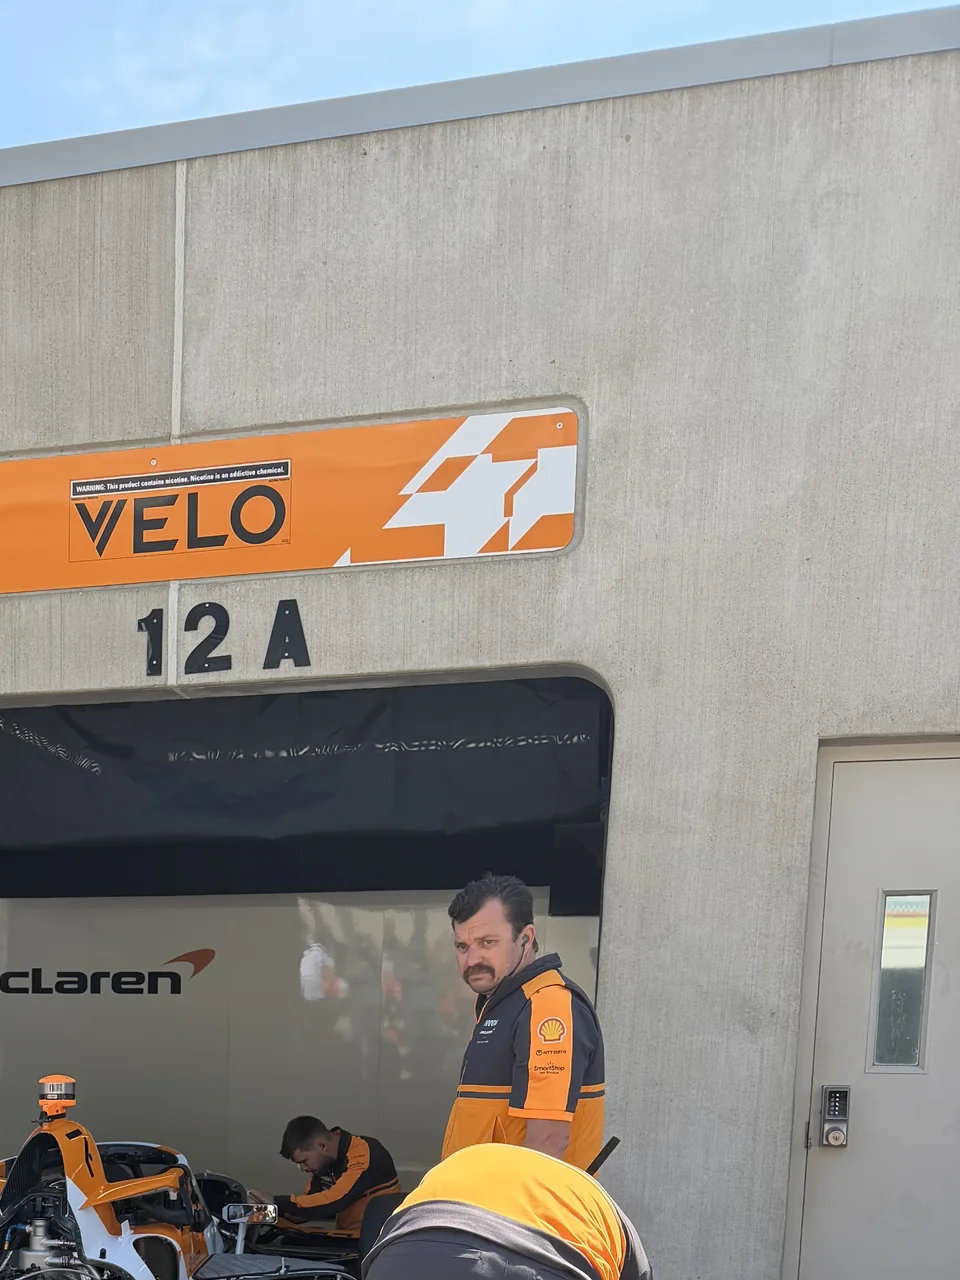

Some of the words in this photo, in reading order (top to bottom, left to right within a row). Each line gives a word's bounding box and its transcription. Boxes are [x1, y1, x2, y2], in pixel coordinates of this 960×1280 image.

[75, 483, 106, 494] WARNING:
[106, 481, 119, 491] This
[119, 480, 141, 491] product
[140, 478, 165, 488] contains
[165, 475, 190, 485] nicotine.
[190, 473, 215, 482] Nicotine
[214, 471, 221, 480] is
[221, 471, 230, 479] an
[229, 468, 256, 478] addictive
[256, 465, 285, 476] chemical.
[74, 484, 286, 558] VELO
[137, 602, 232, 676] 12
[262, 599, 311, 670] A
